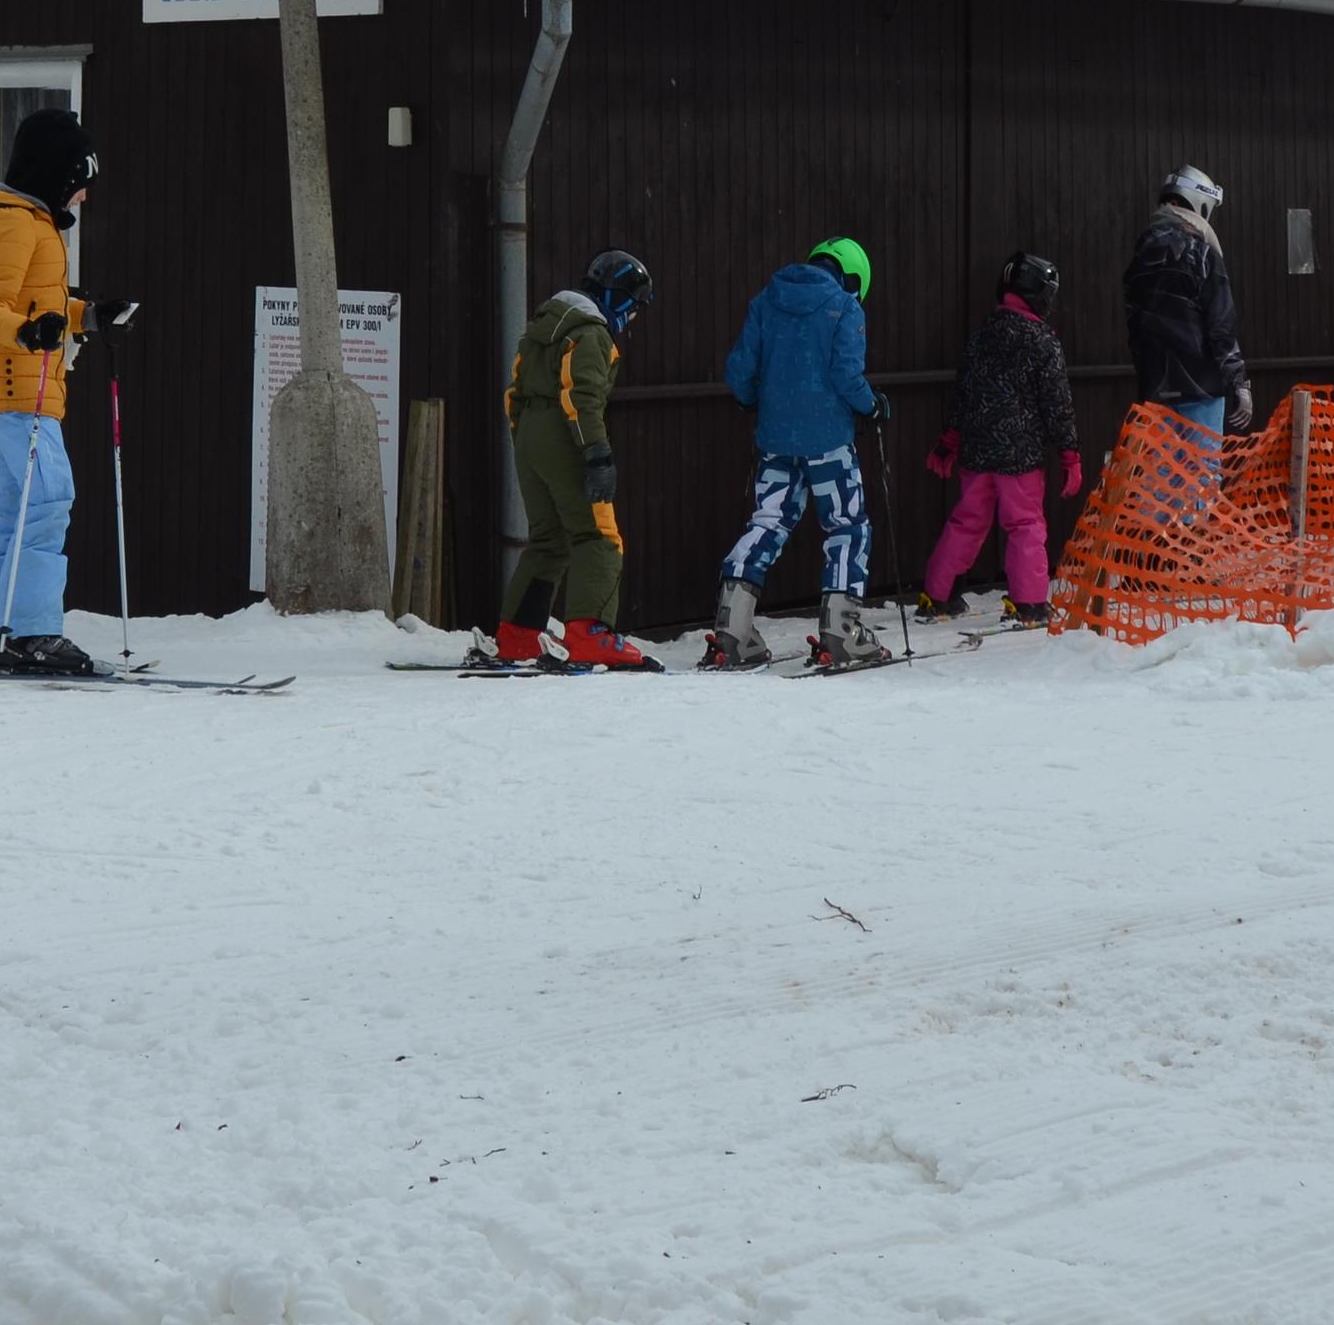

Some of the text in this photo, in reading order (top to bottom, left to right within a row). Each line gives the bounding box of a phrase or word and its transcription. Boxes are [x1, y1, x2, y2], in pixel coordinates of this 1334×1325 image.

[263, 299, 290, 312] POKYNY
[367, 304, 392, 317] OSOBY
[346, 319, 360, 330] EPV
